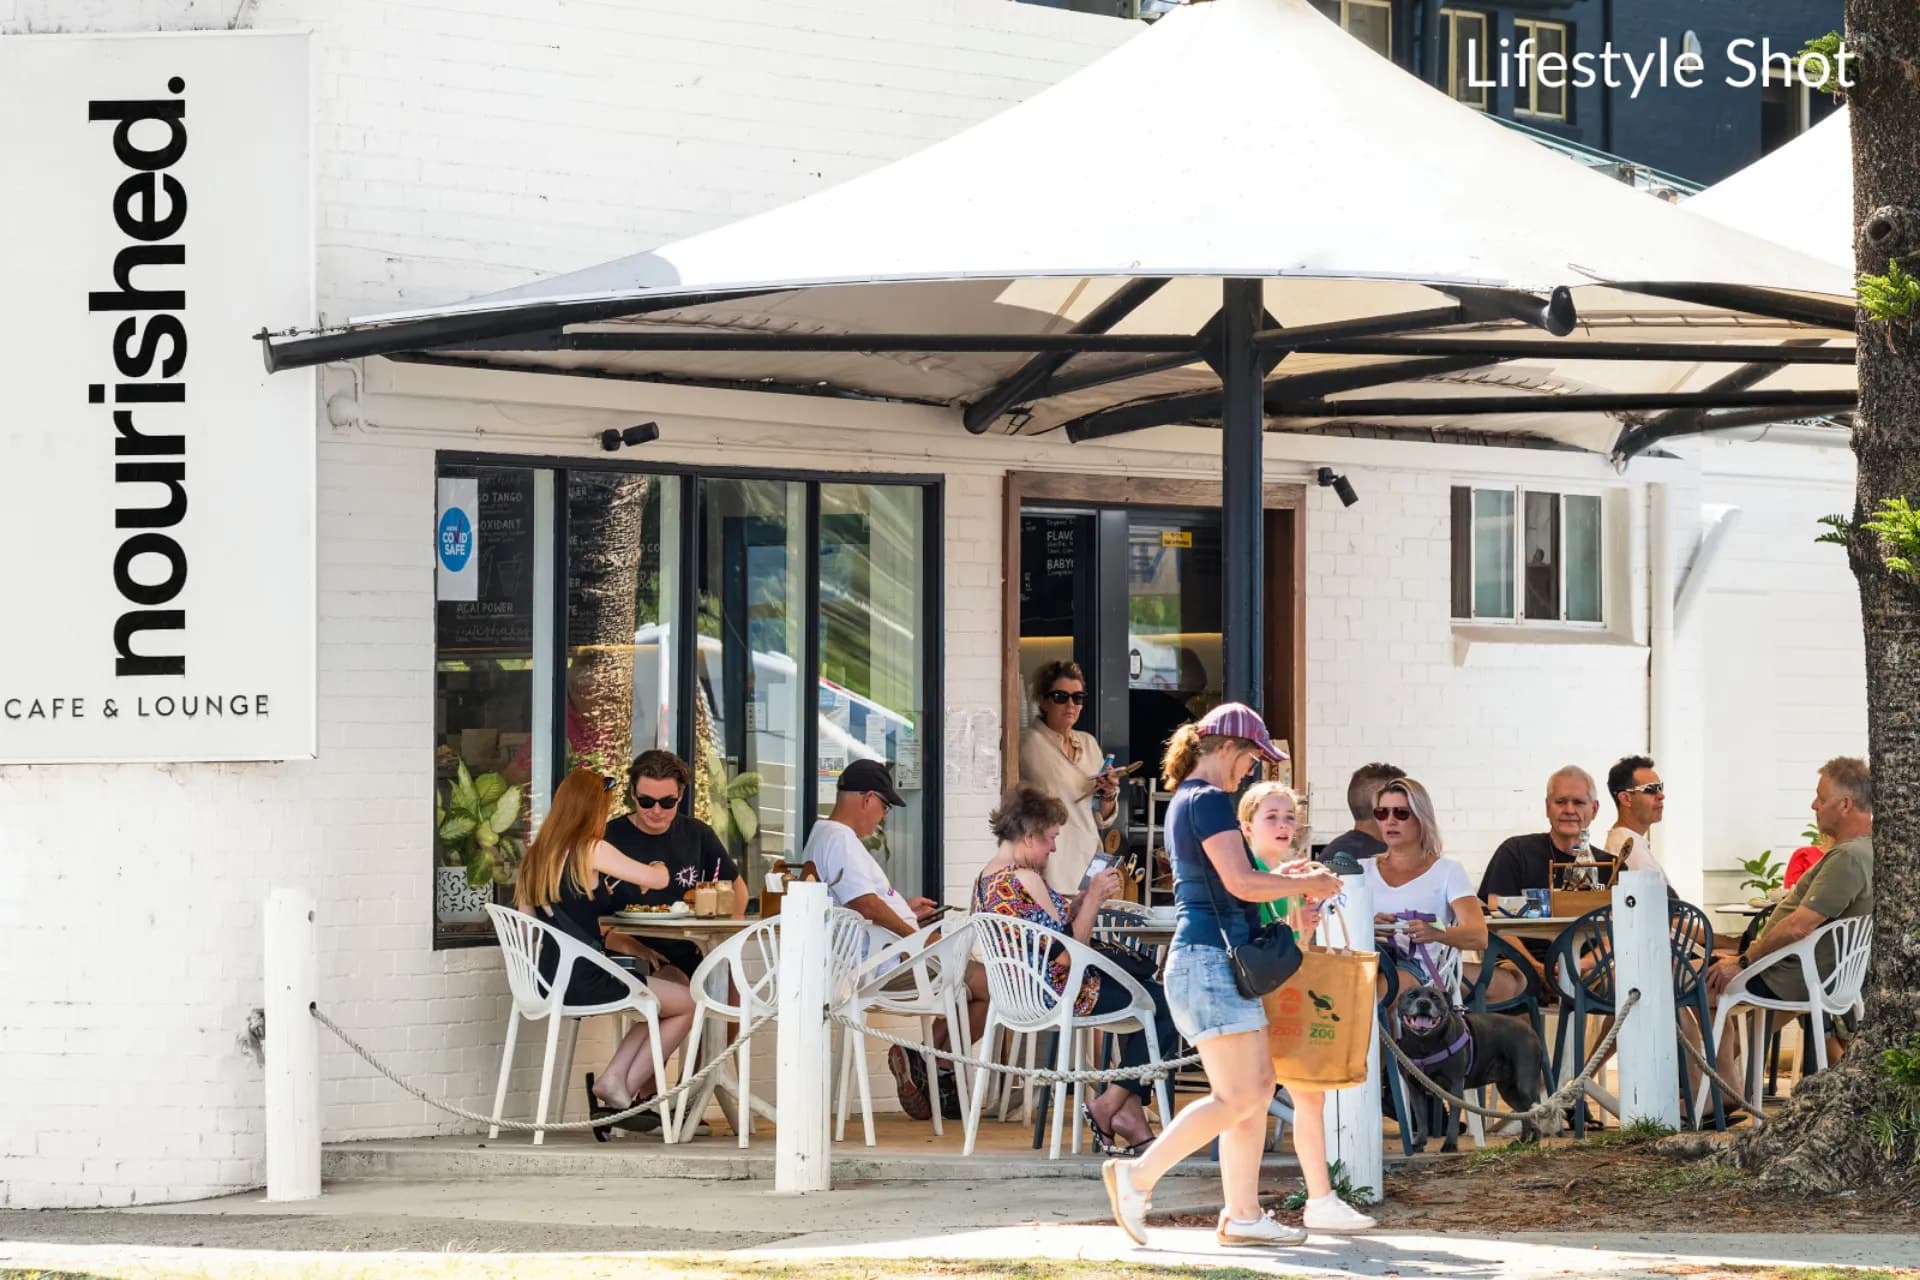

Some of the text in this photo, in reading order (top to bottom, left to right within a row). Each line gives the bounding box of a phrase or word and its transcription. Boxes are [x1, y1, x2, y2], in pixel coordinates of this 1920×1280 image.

[88, 76, 188, 677] nourished.
[492, 492, 523, 503] TANGO
[444, 544, 466, 555] SAFE
[482, 601, 513, 613] POWER
[4, 695, 269, 719] CAFE & LOUNGE
[1310, 1028, 1335, 1040] ZOO
